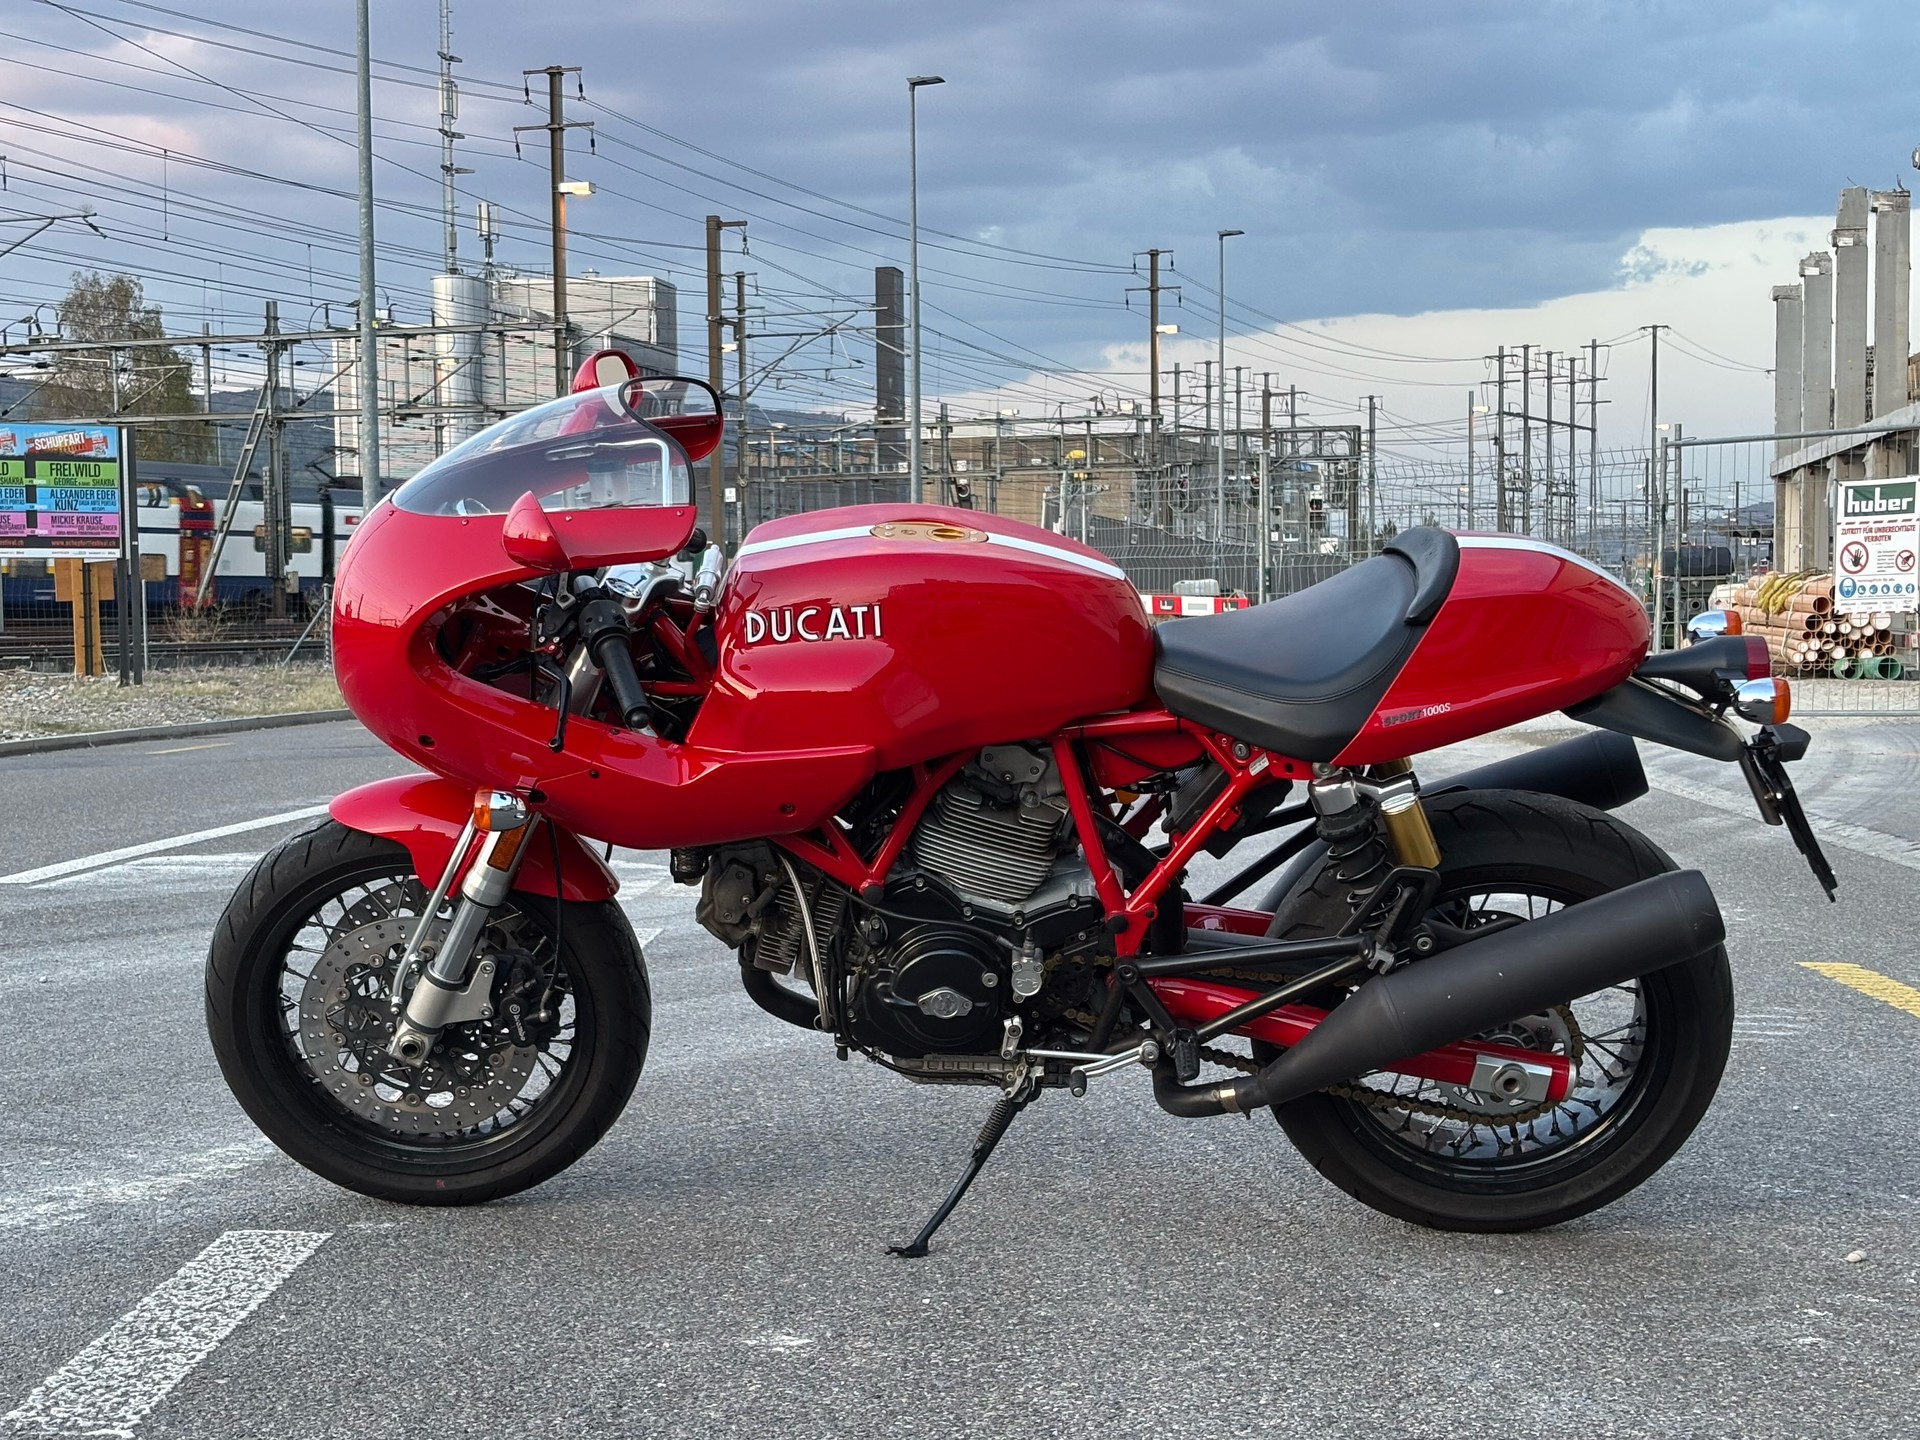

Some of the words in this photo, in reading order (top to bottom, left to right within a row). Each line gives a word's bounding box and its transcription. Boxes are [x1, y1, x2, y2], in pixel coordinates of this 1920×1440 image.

[34, 432, 86, 450] SCHUPFART
[49, 463, 101, 477] FREI.WILD
[53, 477, 78, 486] GEORGE
[92, 478, 116, 487] SHAKRA
[4, 488, 25, 499] EDER
[50, 489, 95, 500] ALEXANDER
[96, 490, 116, 500] EDER
[55, 500, 79, 511] KUNZ
[1847, 487, 1914, 513] huber
[51, 515, 75, 525] MICKIE
[76, 516, 103, 525] KRAUSE
[1841, 527, 1862, 535] ZUTRITT
[1863, 525, 1873, 534] FÜR
[1874, 525, 1916, 533] UNBERECHTIGTE
[744, 604, 882, 644] DUCATI
[1384, 709, 1422, 726] SPORT
[1422, 702, 1451, 717] 1000S
